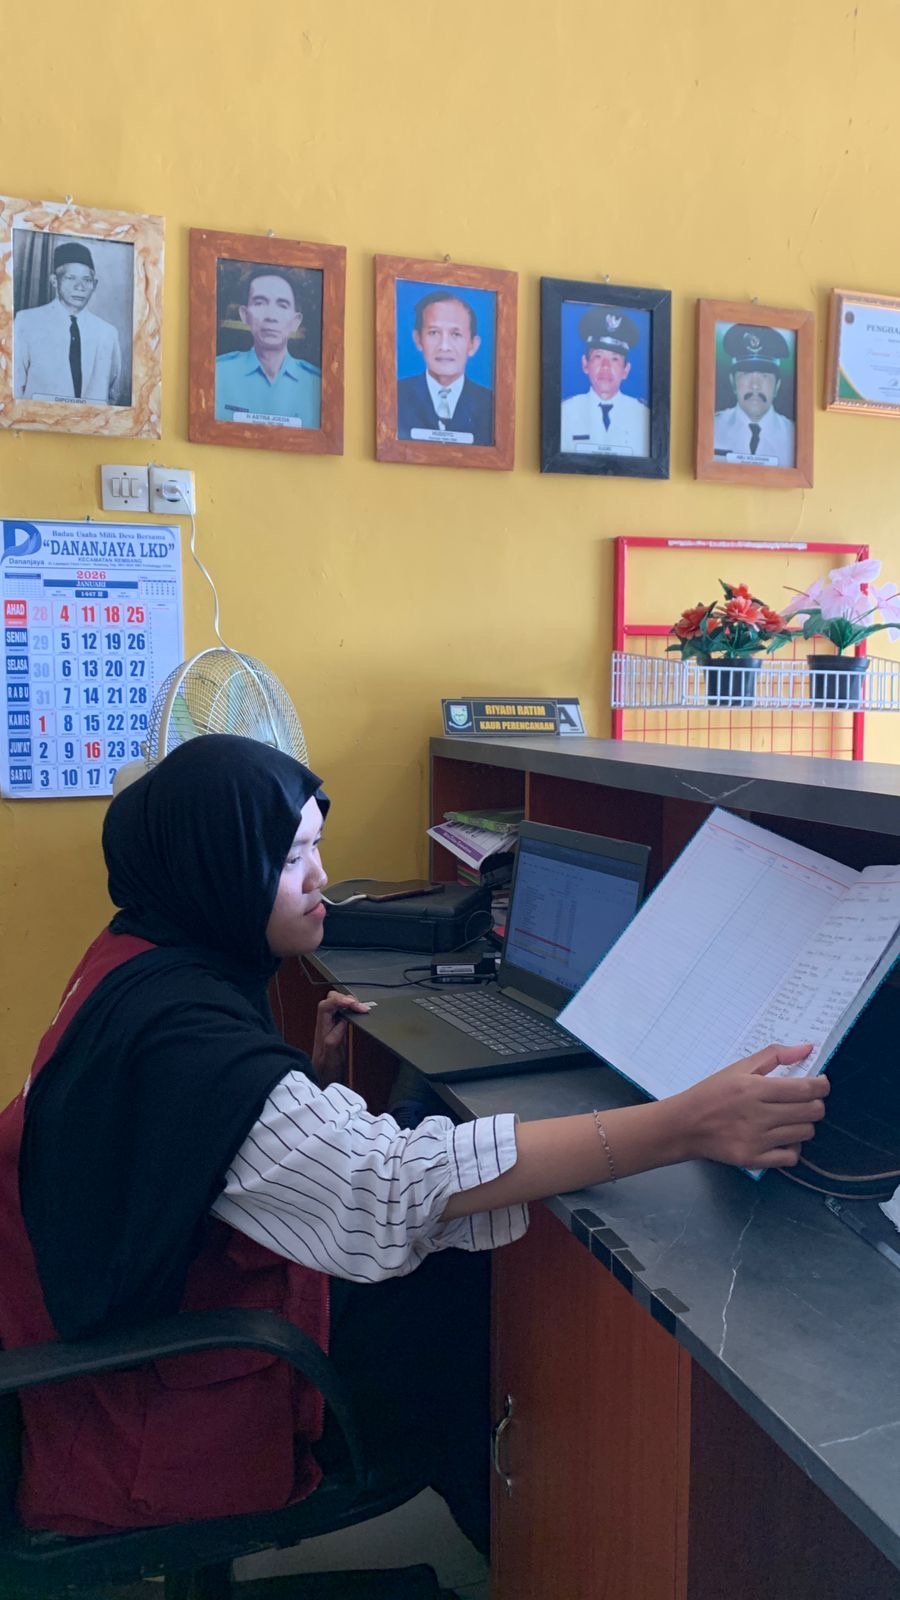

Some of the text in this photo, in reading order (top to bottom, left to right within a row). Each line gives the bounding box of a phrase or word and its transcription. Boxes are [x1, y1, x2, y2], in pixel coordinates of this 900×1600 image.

[9, 557, 45, 566] Dananjaya
[76, 570, 107, 580] 2026
[76, 580, 106, 588] JANUARI
[6, 603, 145, 623] AHAD 28 4 11 18 25
[6, 631, 146, 650] SENIN 29 5 12 19 26
[6, 659, 146, 678] SELASA 30 6 13 20 27
[8, 686, 147, 705] RABU 31 7 14 21 28
[8, 714, 148, 732] KAMIS 1 8 15 22 29
[479, 721, 554, 731] KAUR PERENCANAAN
[40, 742, 48, 759] 2
[64, 742, 74, 759] 9
[85, 741, 101, 759] 16
[108, 741, 125, 758] 23
[10, 769, 32, 781] SABTU
[40, 770, 50, 787] 3
[62, 769, 78, 786] 10
[87, 768, 101, 785] 17
